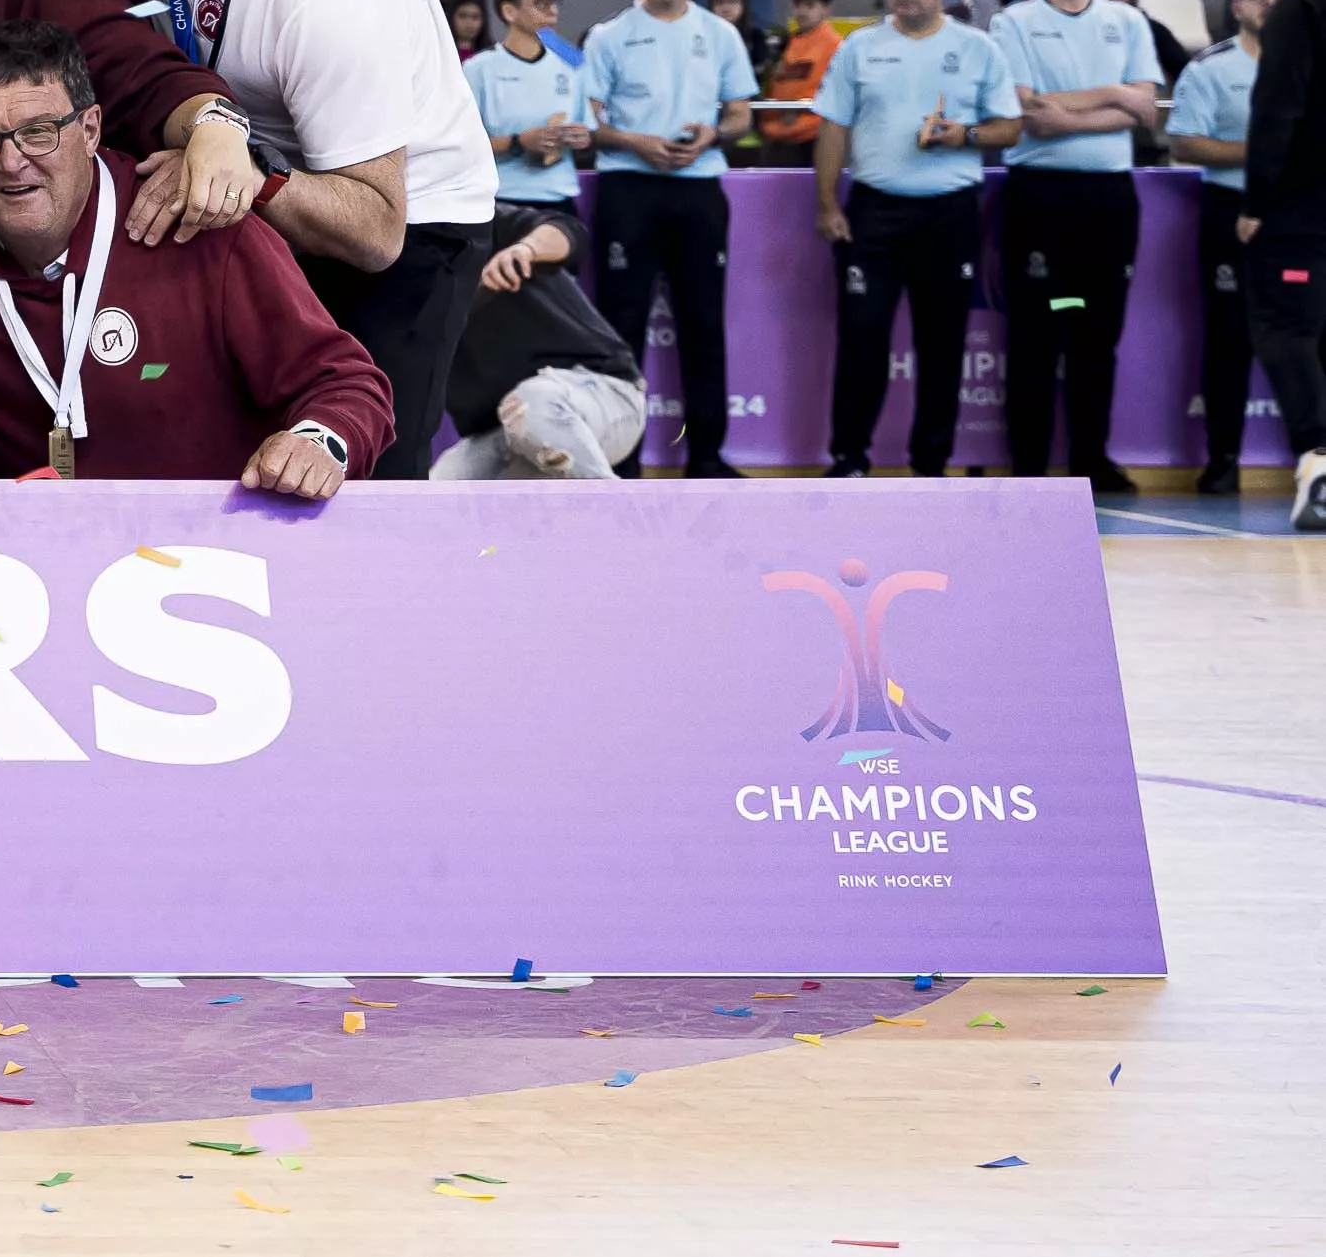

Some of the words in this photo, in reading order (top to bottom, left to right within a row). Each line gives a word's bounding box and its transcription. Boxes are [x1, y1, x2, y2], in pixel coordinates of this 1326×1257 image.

[858, 758, 901, 775] WSE
[735, 784, 1038, 822] CHAMPIONS
[833, 830, 949, 855] LEAGUE
[838, 874, 879, 888] RINK
[884, 874, 954, 888] HOCKEY
